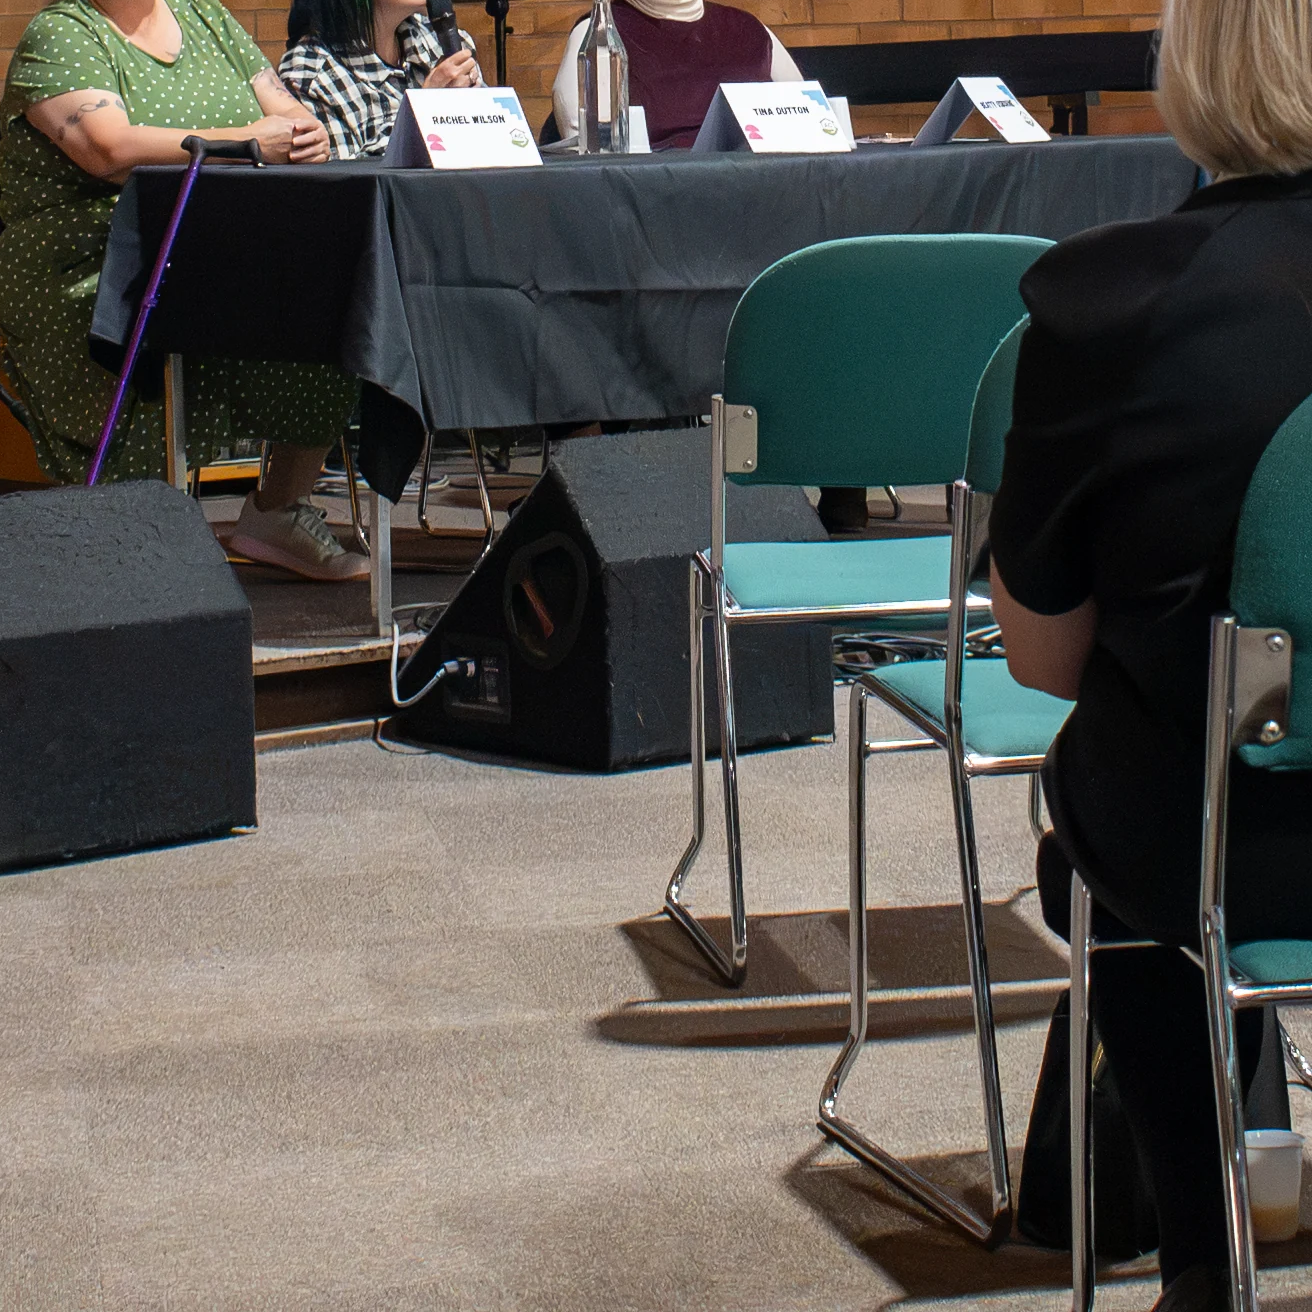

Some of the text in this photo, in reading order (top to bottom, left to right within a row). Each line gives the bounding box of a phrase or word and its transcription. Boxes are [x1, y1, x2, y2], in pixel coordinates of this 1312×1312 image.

[753, 106, 810, 116] TINA DUTTON
[432, 114, 506, 125] RACHEL WILSON
